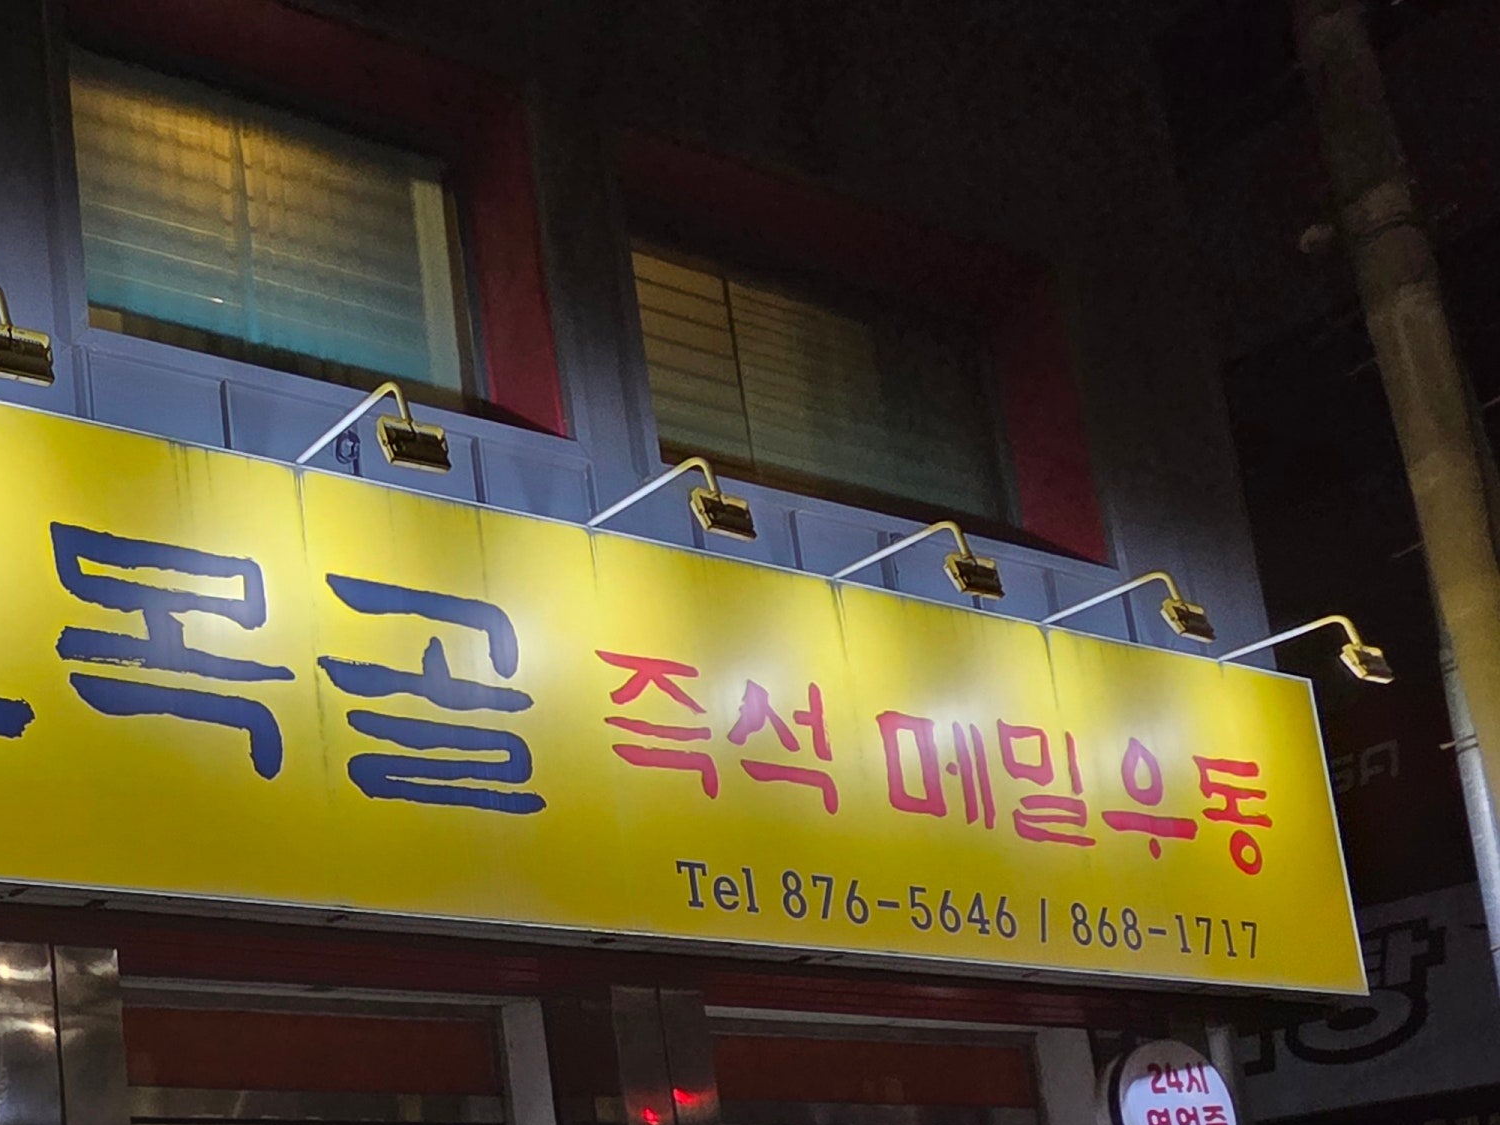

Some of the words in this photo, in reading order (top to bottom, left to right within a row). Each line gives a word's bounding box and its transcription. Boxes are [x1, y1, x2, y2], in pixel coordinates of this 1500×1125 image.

[594, 649, 839, 816] 즉석
[876, 709, 1274, 875] 메밀우동
[675, 858, 759, 914] Tel
[781, 869, 1018, 940] 876-5646
[1071, 903, 1260, 961] 868-1717
[1147, 1060, 1209, 1094] 24시
